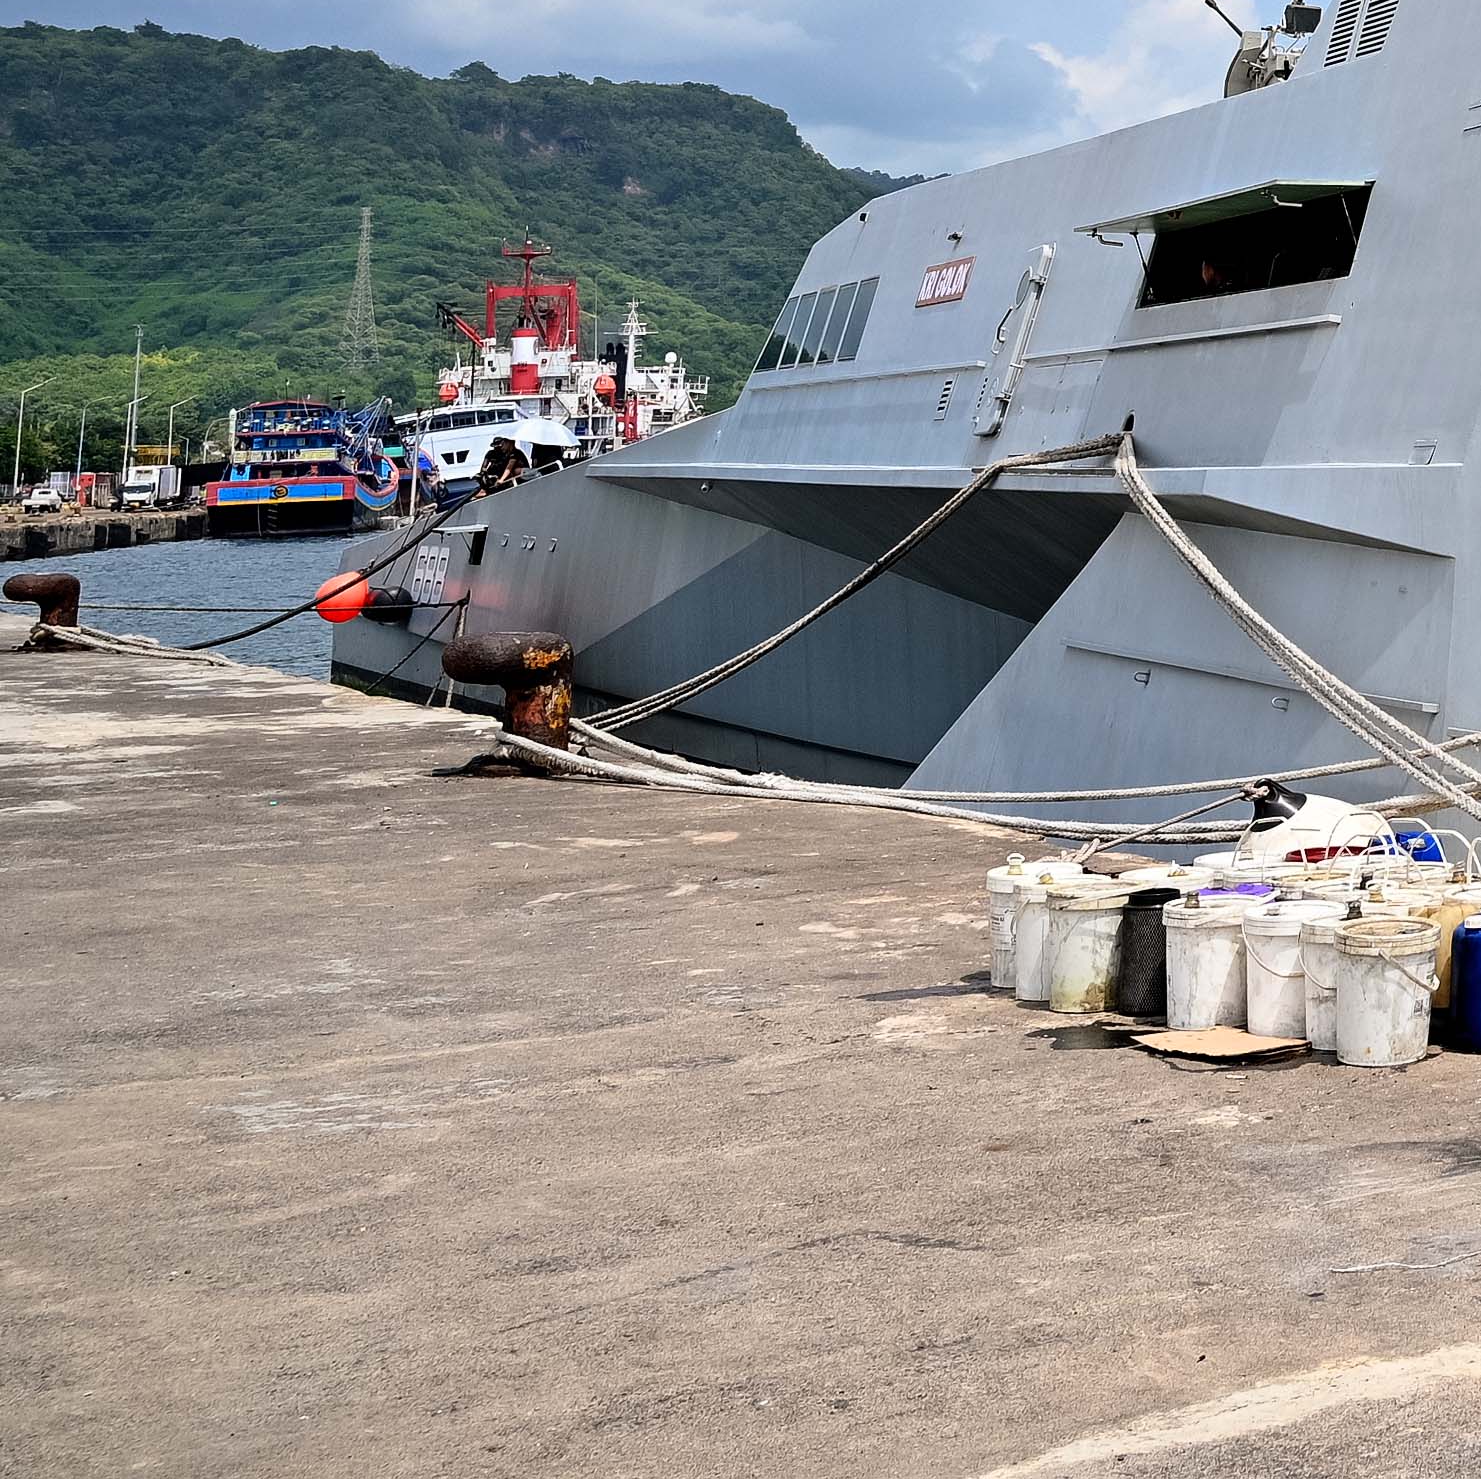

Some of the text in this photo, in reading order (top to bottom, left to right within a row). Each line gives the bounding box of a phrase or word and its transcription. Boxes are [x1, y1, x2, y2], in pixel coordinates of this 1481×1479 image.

[918, 262, 971, 302] KRI GOLOK
[411, 545, 450, 605] 688
